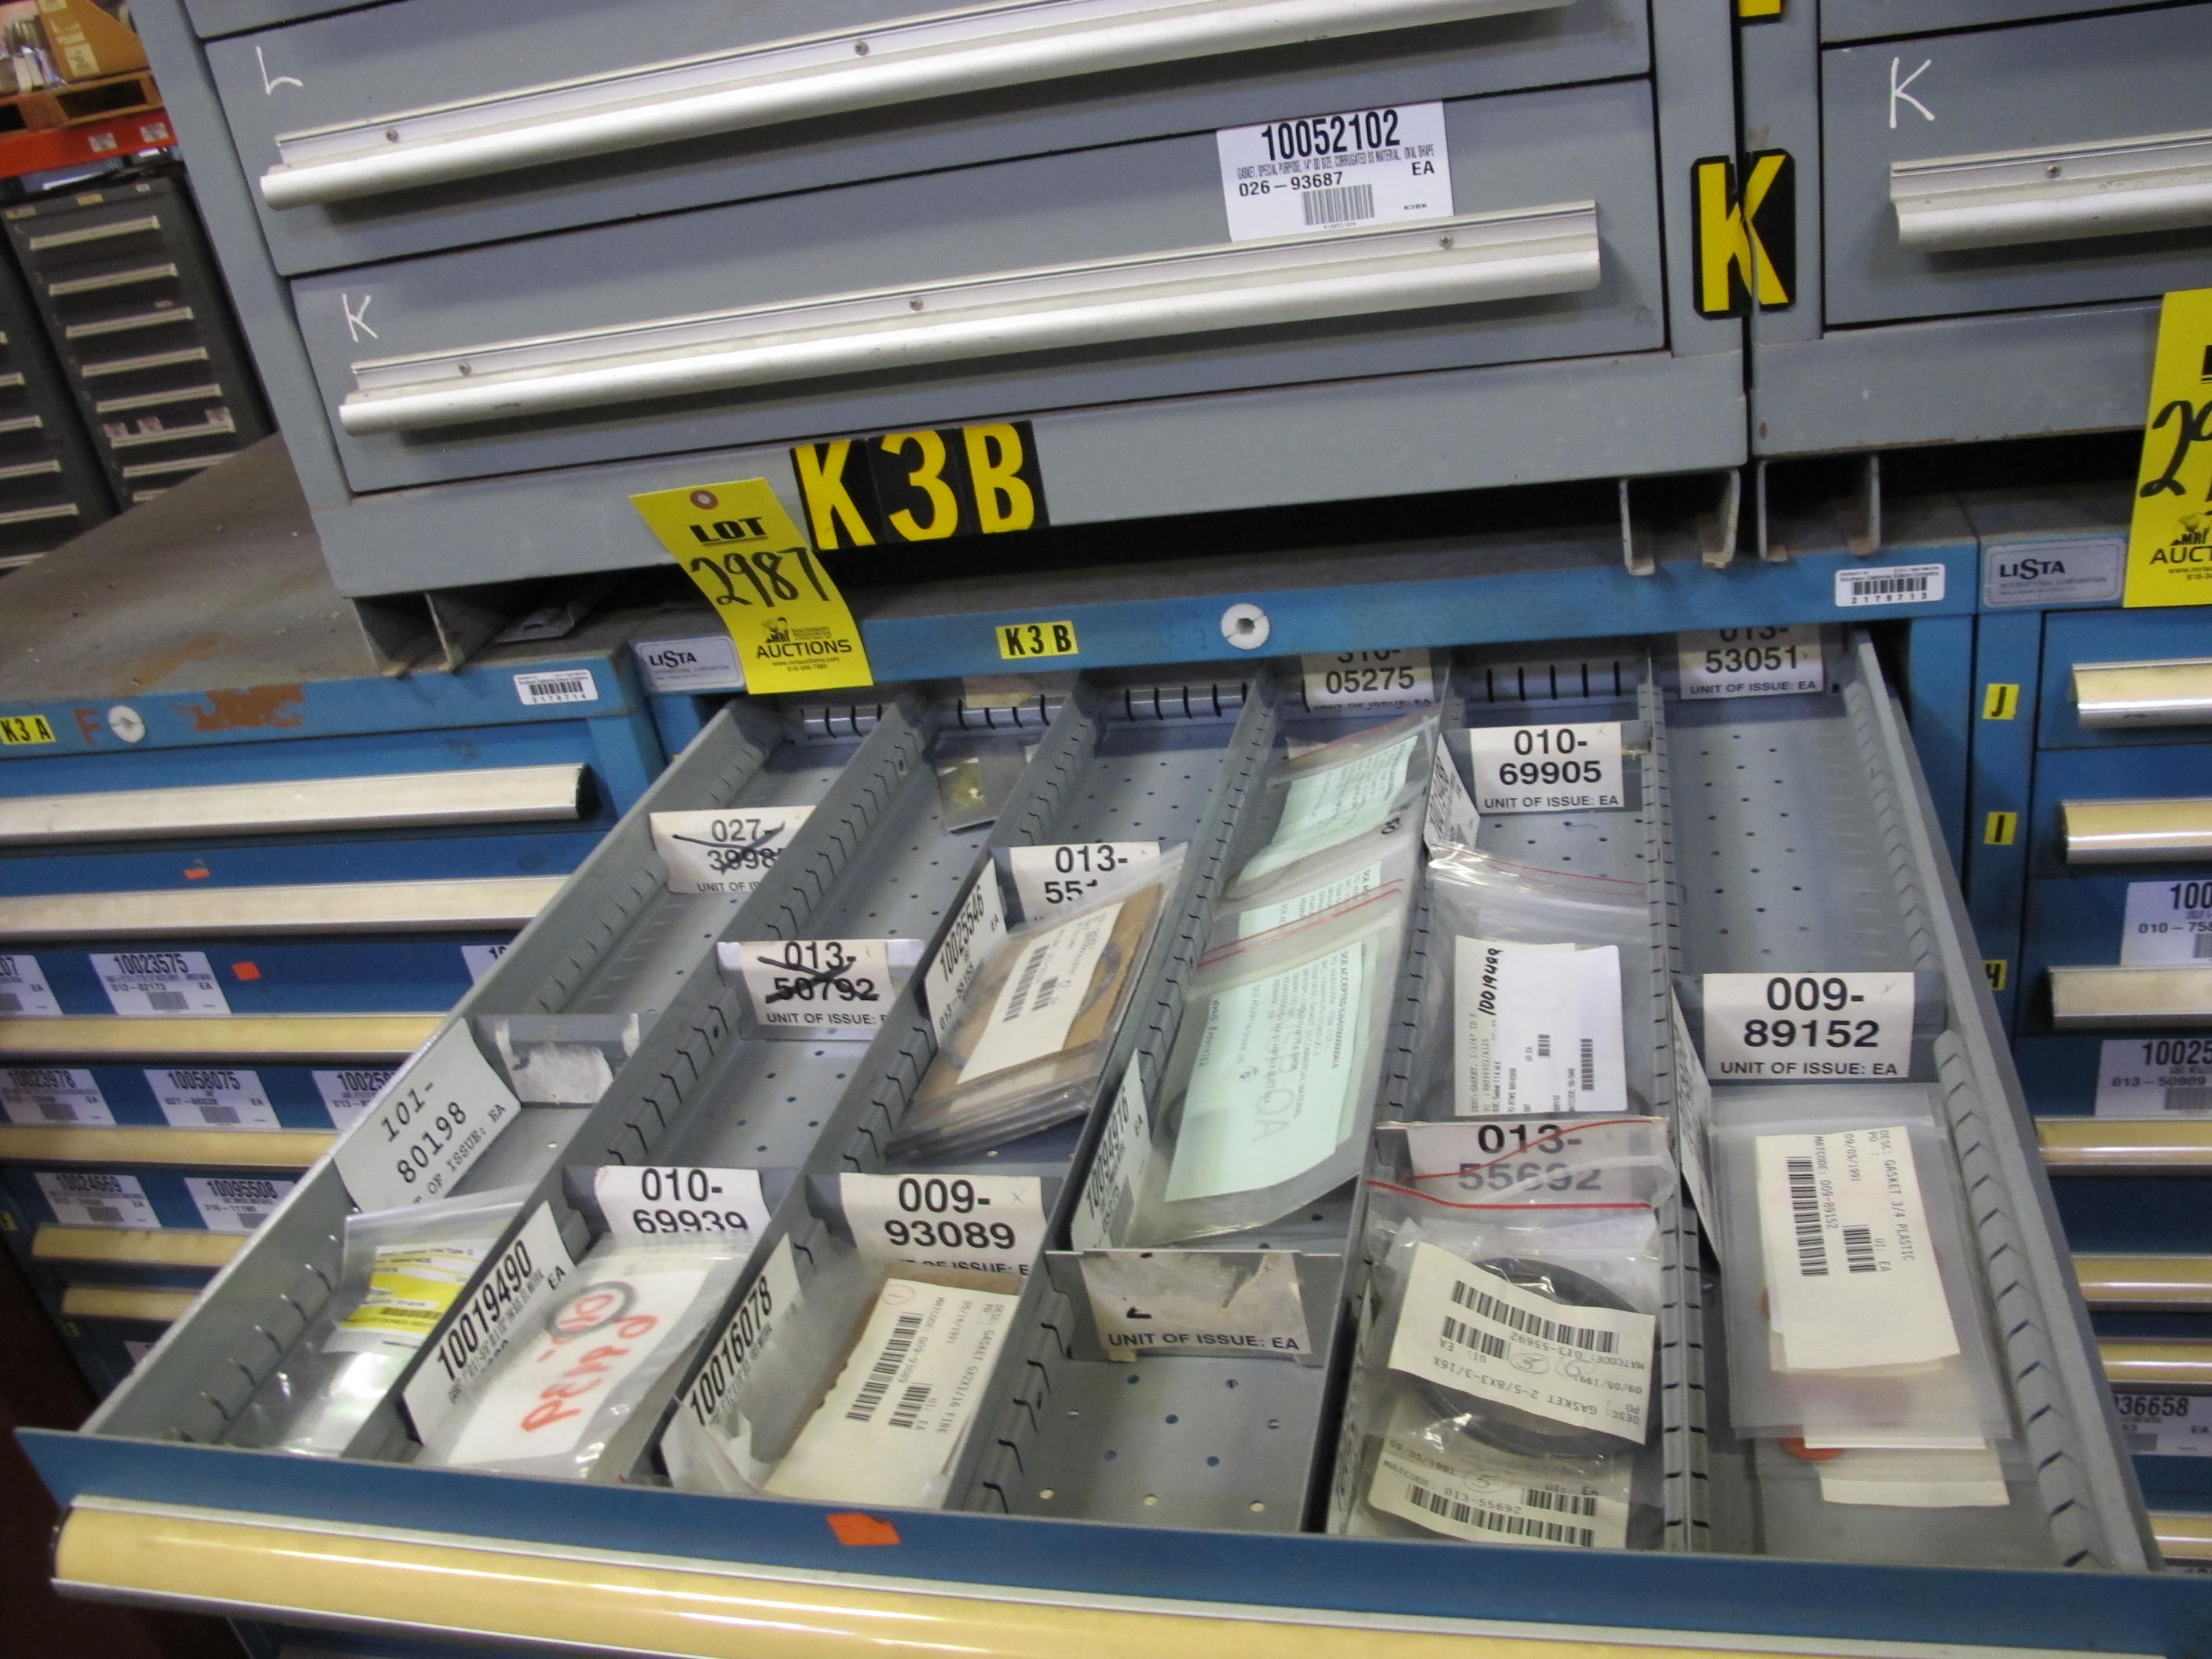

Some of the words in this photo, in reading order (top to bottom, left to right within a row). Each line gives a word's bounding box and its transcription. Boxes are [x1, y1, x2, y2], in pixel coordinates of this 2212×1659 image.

[1890, 57, 1935, 128] K
[1262, 109, 1401, 161] 10052102
[1412, 160, 1435, 176] EA
[1698, 155, 1789, 312] K
[341, 292, 378, 342] K
[795, 423, 1035, 550] K3B
[690, 516, 767, 542] LOT
[690, 547, 830, 608] 2987
[2000, 558, 2065, 580] LISTA
[756, 639, 852, 659] AUCTIONS
[1005, 624, 1072, 656] K3B
[649, 650, 698, 668] LISTA
[1705, 645, 1797, 673] 53051
[1326, 666, 1415, 694] 05275
[1690, 685, 1721, 694] UNIT
[1749, 682, 1793, 691] ISSUE:
[1798, 681, 1816, 690] EA
[1991, 686, 2007, 718] J
[1514, 728, 1588, 755] 010-
[1499, 760, 1602, 786] 69905
[1484, 798, 1519, 809] UNIT
[1523, 797, 1544, 808] OF
[1547, 796, 1595, 808] ISSUE:
[1599, 795, 1619, 807] EA
[1056, 844, 1128, 873] 013-
[698, 883, 726, 892] UNIT
[730, 883, 745, 892] OF
[113, 954, 189, 974] 10023575
[785, 942, 857, 970] 013-
[200, 982, 213, 991] EA
[1767, 977, 1865, 1011] 009-
[767, 1013, 800, 1024] UNIT
[804, 1013, 823, 1024] OF
[828, 1014, 877, 1024] ISSUE:
[1743, 1020, 1879, 1048] 89152
[1720, 1062, 1764, 1075] UNIT
[1771, 1062, 1796, 1075] OF
[1804, 1062, 1866, 1075] ISSUE:
[1872, 1062, 1897, 1076] EA
[397, 1101, 466, 1183] 80198
[427, 1173, 444, 1195] OF
[488, 1104, 506, 1122] EA
[1478, 1125, 1582, 1155] 013-
[642, 1169, 723, 1202] 010-
[1885, 1159, 1902, 1195] GASKET
[899, 1178, 991, 1213] 009-
[1891, 1201, 1906, 1218] 3/4
[884, 1219, 1016, 1249] 93089
[1896, 1223, 1915, 1262] PLASTIC
[548, 1265, 565, 1291] EA
[437, 1240, 532, 1380] 10019490
[690, 1275, 772, 1426] 10016078
[1108, 1333, 1155, 1346] UNIT
[1163, 1333, 1188, 1344] OF
[1198, 1335, 1265, 1347] ISSUE:
[1272, 1337, 1299, 1350] EA
[1440, 1339, 1454, 1351] EA
[1547, 1394, 1598, 1415] GASKET
[2115, 1396, 2188, 1416] 36658
